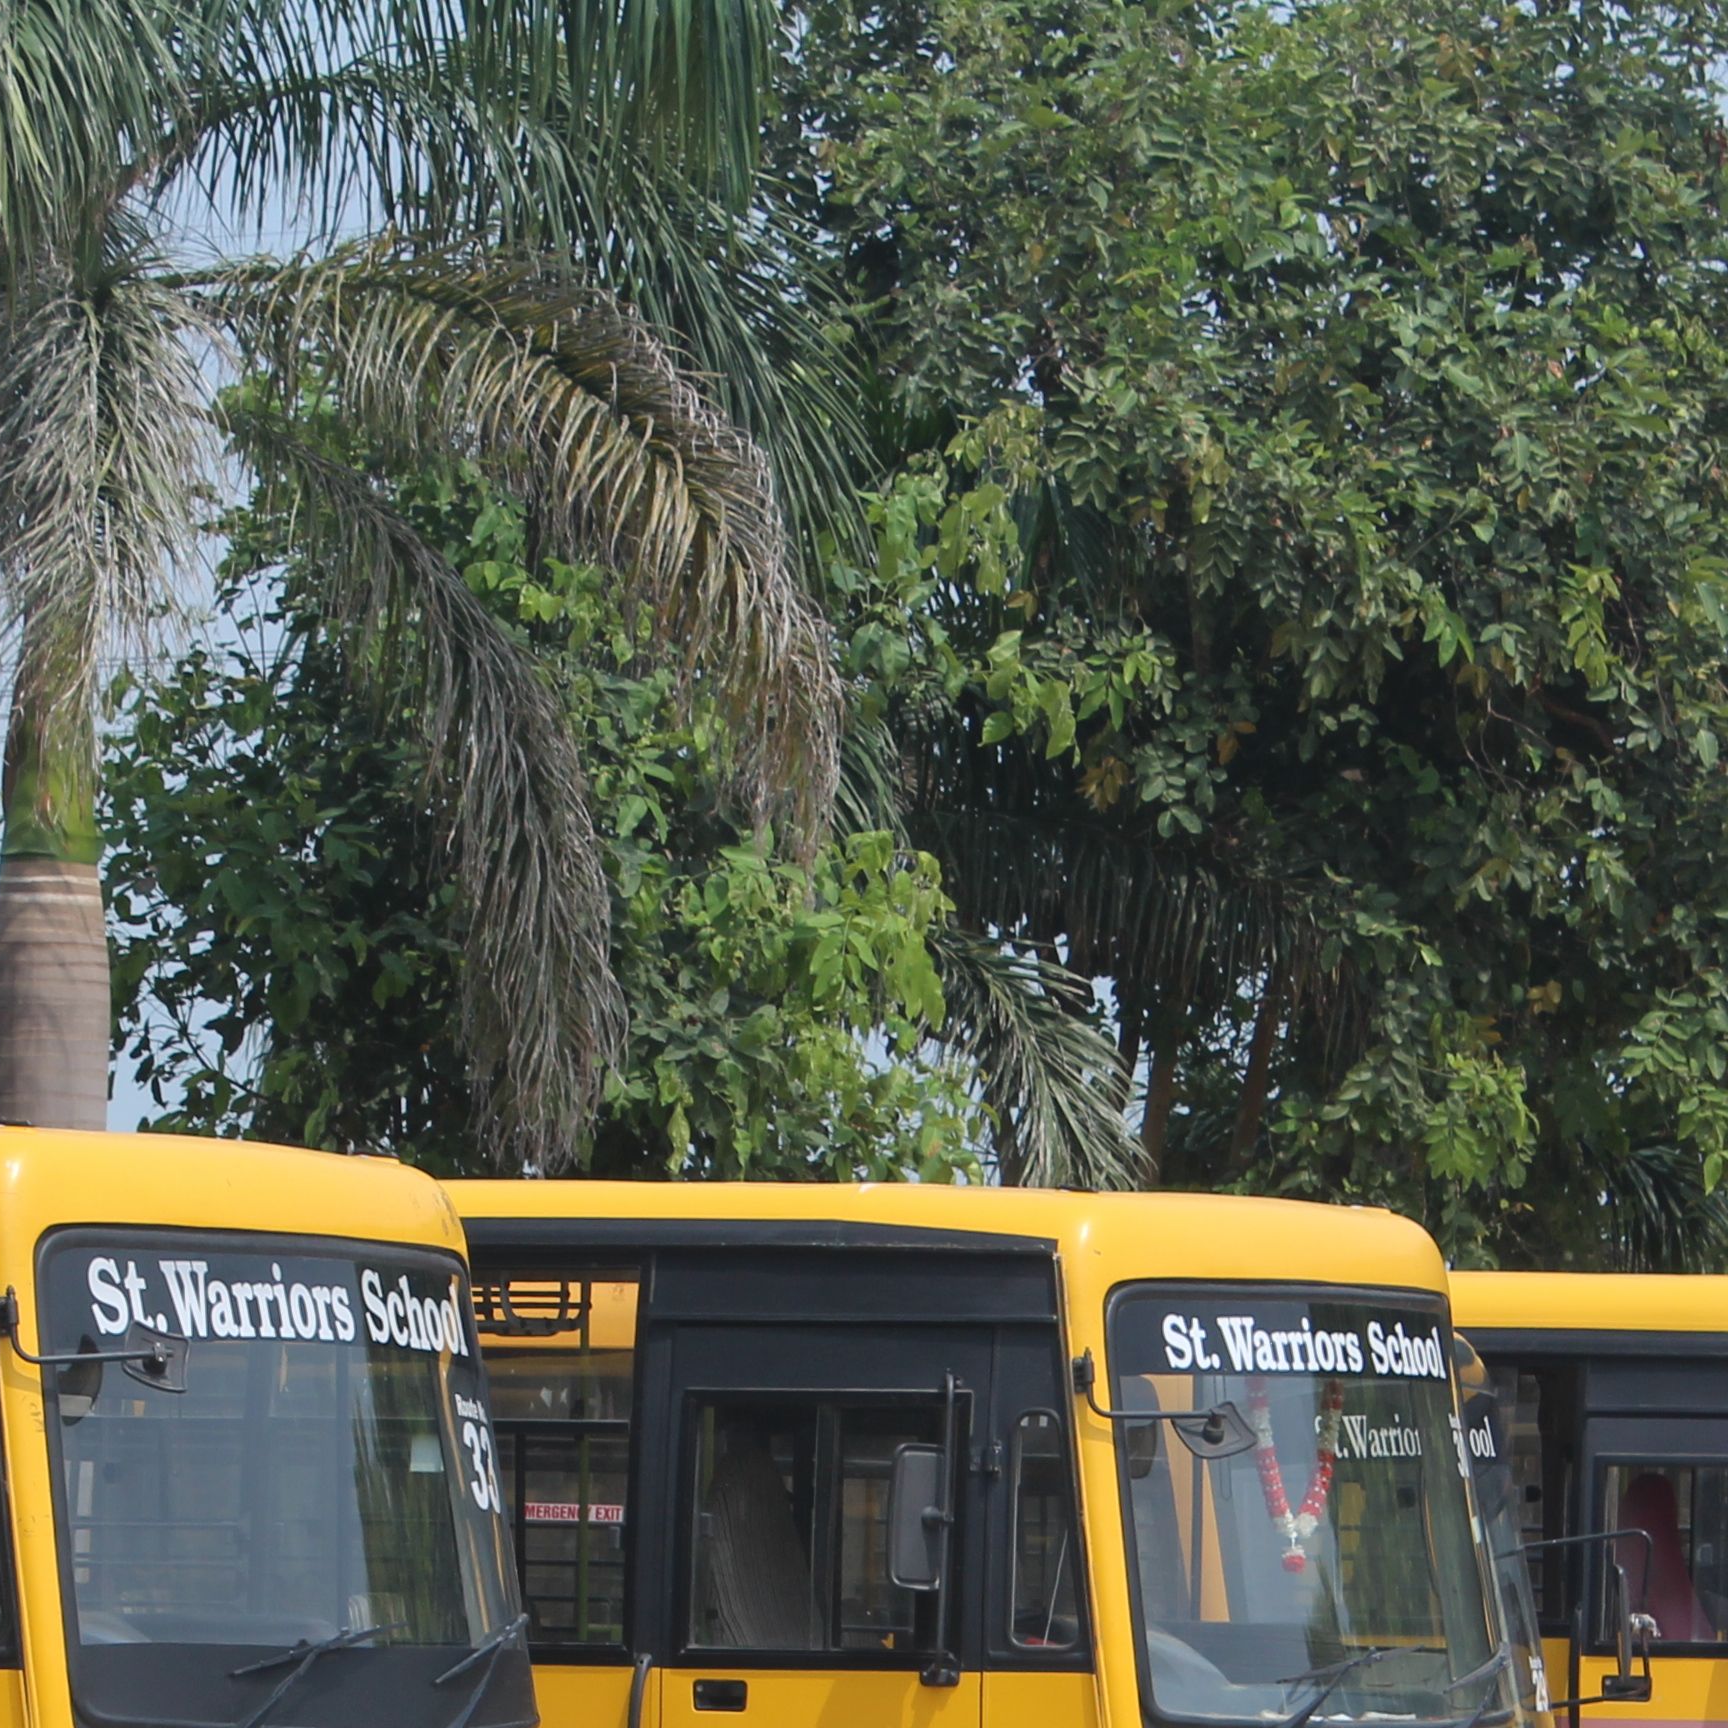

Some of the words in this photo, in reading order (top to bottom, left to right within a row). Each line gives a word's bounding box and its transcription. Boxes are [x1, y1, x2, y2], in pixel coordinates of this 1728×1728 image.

[360, 1267, 470, 1358] School
[1367, 1320, 1447, 1380] School
[1469, 1415, 1497, 1458] ool
[462, 1420, 502, 1515] 33
[524, 1504, 592, 1521] MERGEN
[595, 1505, 622, 1521] EXIT
